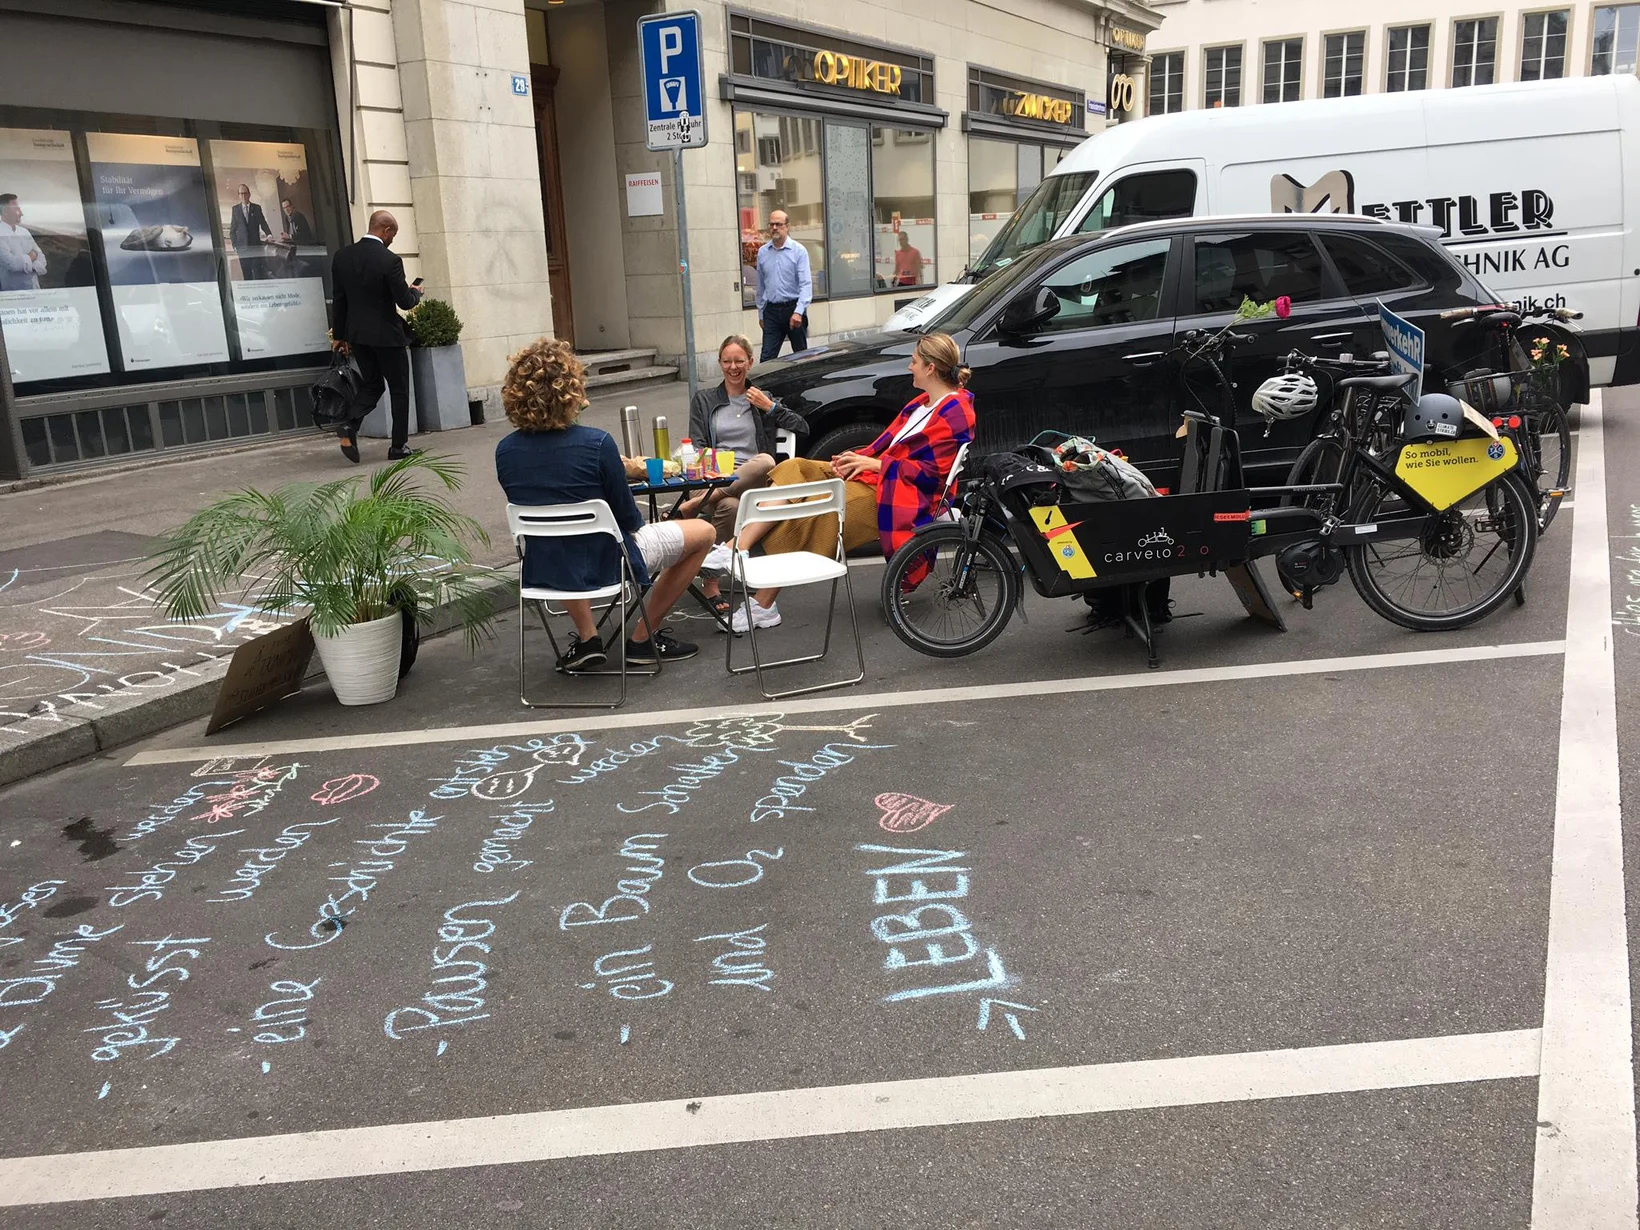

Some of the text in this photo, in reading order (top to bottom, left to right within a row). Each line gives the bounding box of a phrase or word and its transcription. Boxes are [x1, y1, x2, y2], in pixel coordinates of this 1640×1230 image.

[659, 26, 683, 74] P
[814, 50, 902, 95] OPTIKER
[514, 78, 527, 93] 29
[1014, 91, 1073, 125] ZWICKER
[649, 119, 702, 132] Zentrale Puhr
[100, 175, 132, 184] Stabilität
[628, 178, 659, 188] RAIFFEISEN
[128, 187, 164, 197] Vermögen
[1535, 245, 1570, 269] AG
[1509, 293, 1566, 311] nik.ch
[1405, 448, 1451, 459] So mobil,
[1405, 455, 1478, 469] wie Sie wollen.
[1104, 547, 1172, 563] carvelo
[693, 923, 775, 991] und
[751, 742, 899, 822] spenden
[559, 833, 669, 930] Baum
[854, 843, 1010, 1003] LEBEN
[384, 890, 519, 1040] Pausen
[575, 944, 675, 1000] ein
